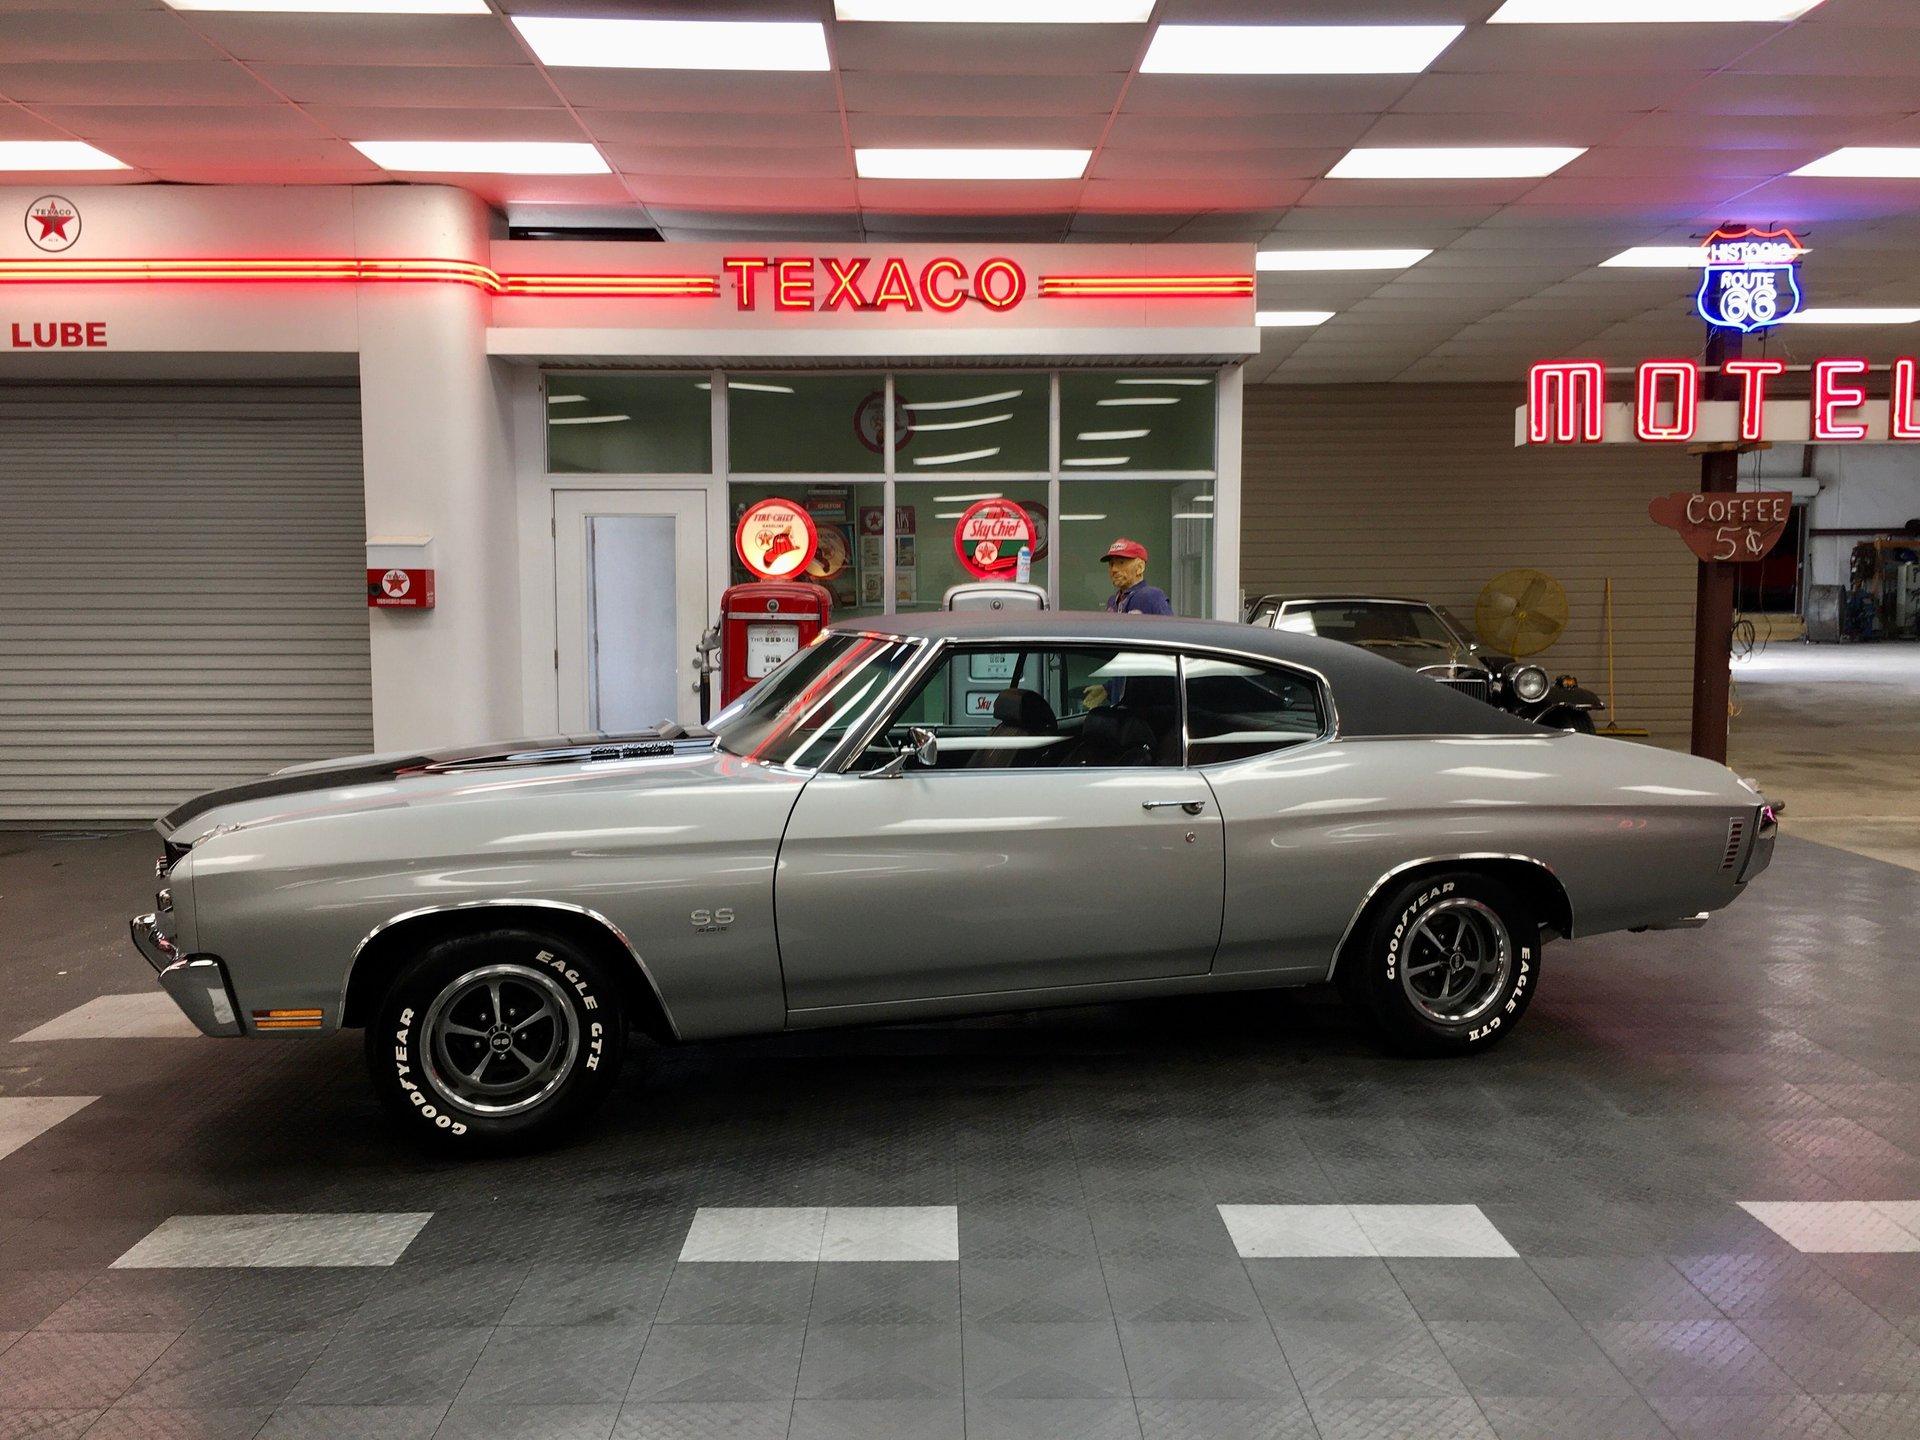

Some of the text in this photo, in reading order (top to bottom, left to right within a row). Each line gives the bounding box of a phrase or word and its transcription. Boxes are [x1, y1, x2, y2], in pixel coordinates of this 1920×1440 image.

[35, 208, 72, 216] TEXACO
[1711, 242, 1790, 262] HISTORIC
[723, 257, 1026, 313] TEXACO
[1720, 271, 1775, 289] ROUTE
[1720, 287, 1777, 322] 66
[11, 322, 108, 348] LUBE
[1527, 358, 1920, 443] MOTEL
[1686, 493, 1785, 524] COFFEE
[970, 518, 1021, 541] Sky Chief
[975, 696, 992, 711] Sky
[690, 908, 735, 926] SS
[1387, 882, 1455, 980] GOODYEAR
[535, 950, 598, 1010] EAGLE
[1505, 947, 1531, 1014] EAGLE
[395, 1007, 468, 1136] GOODYEAR
